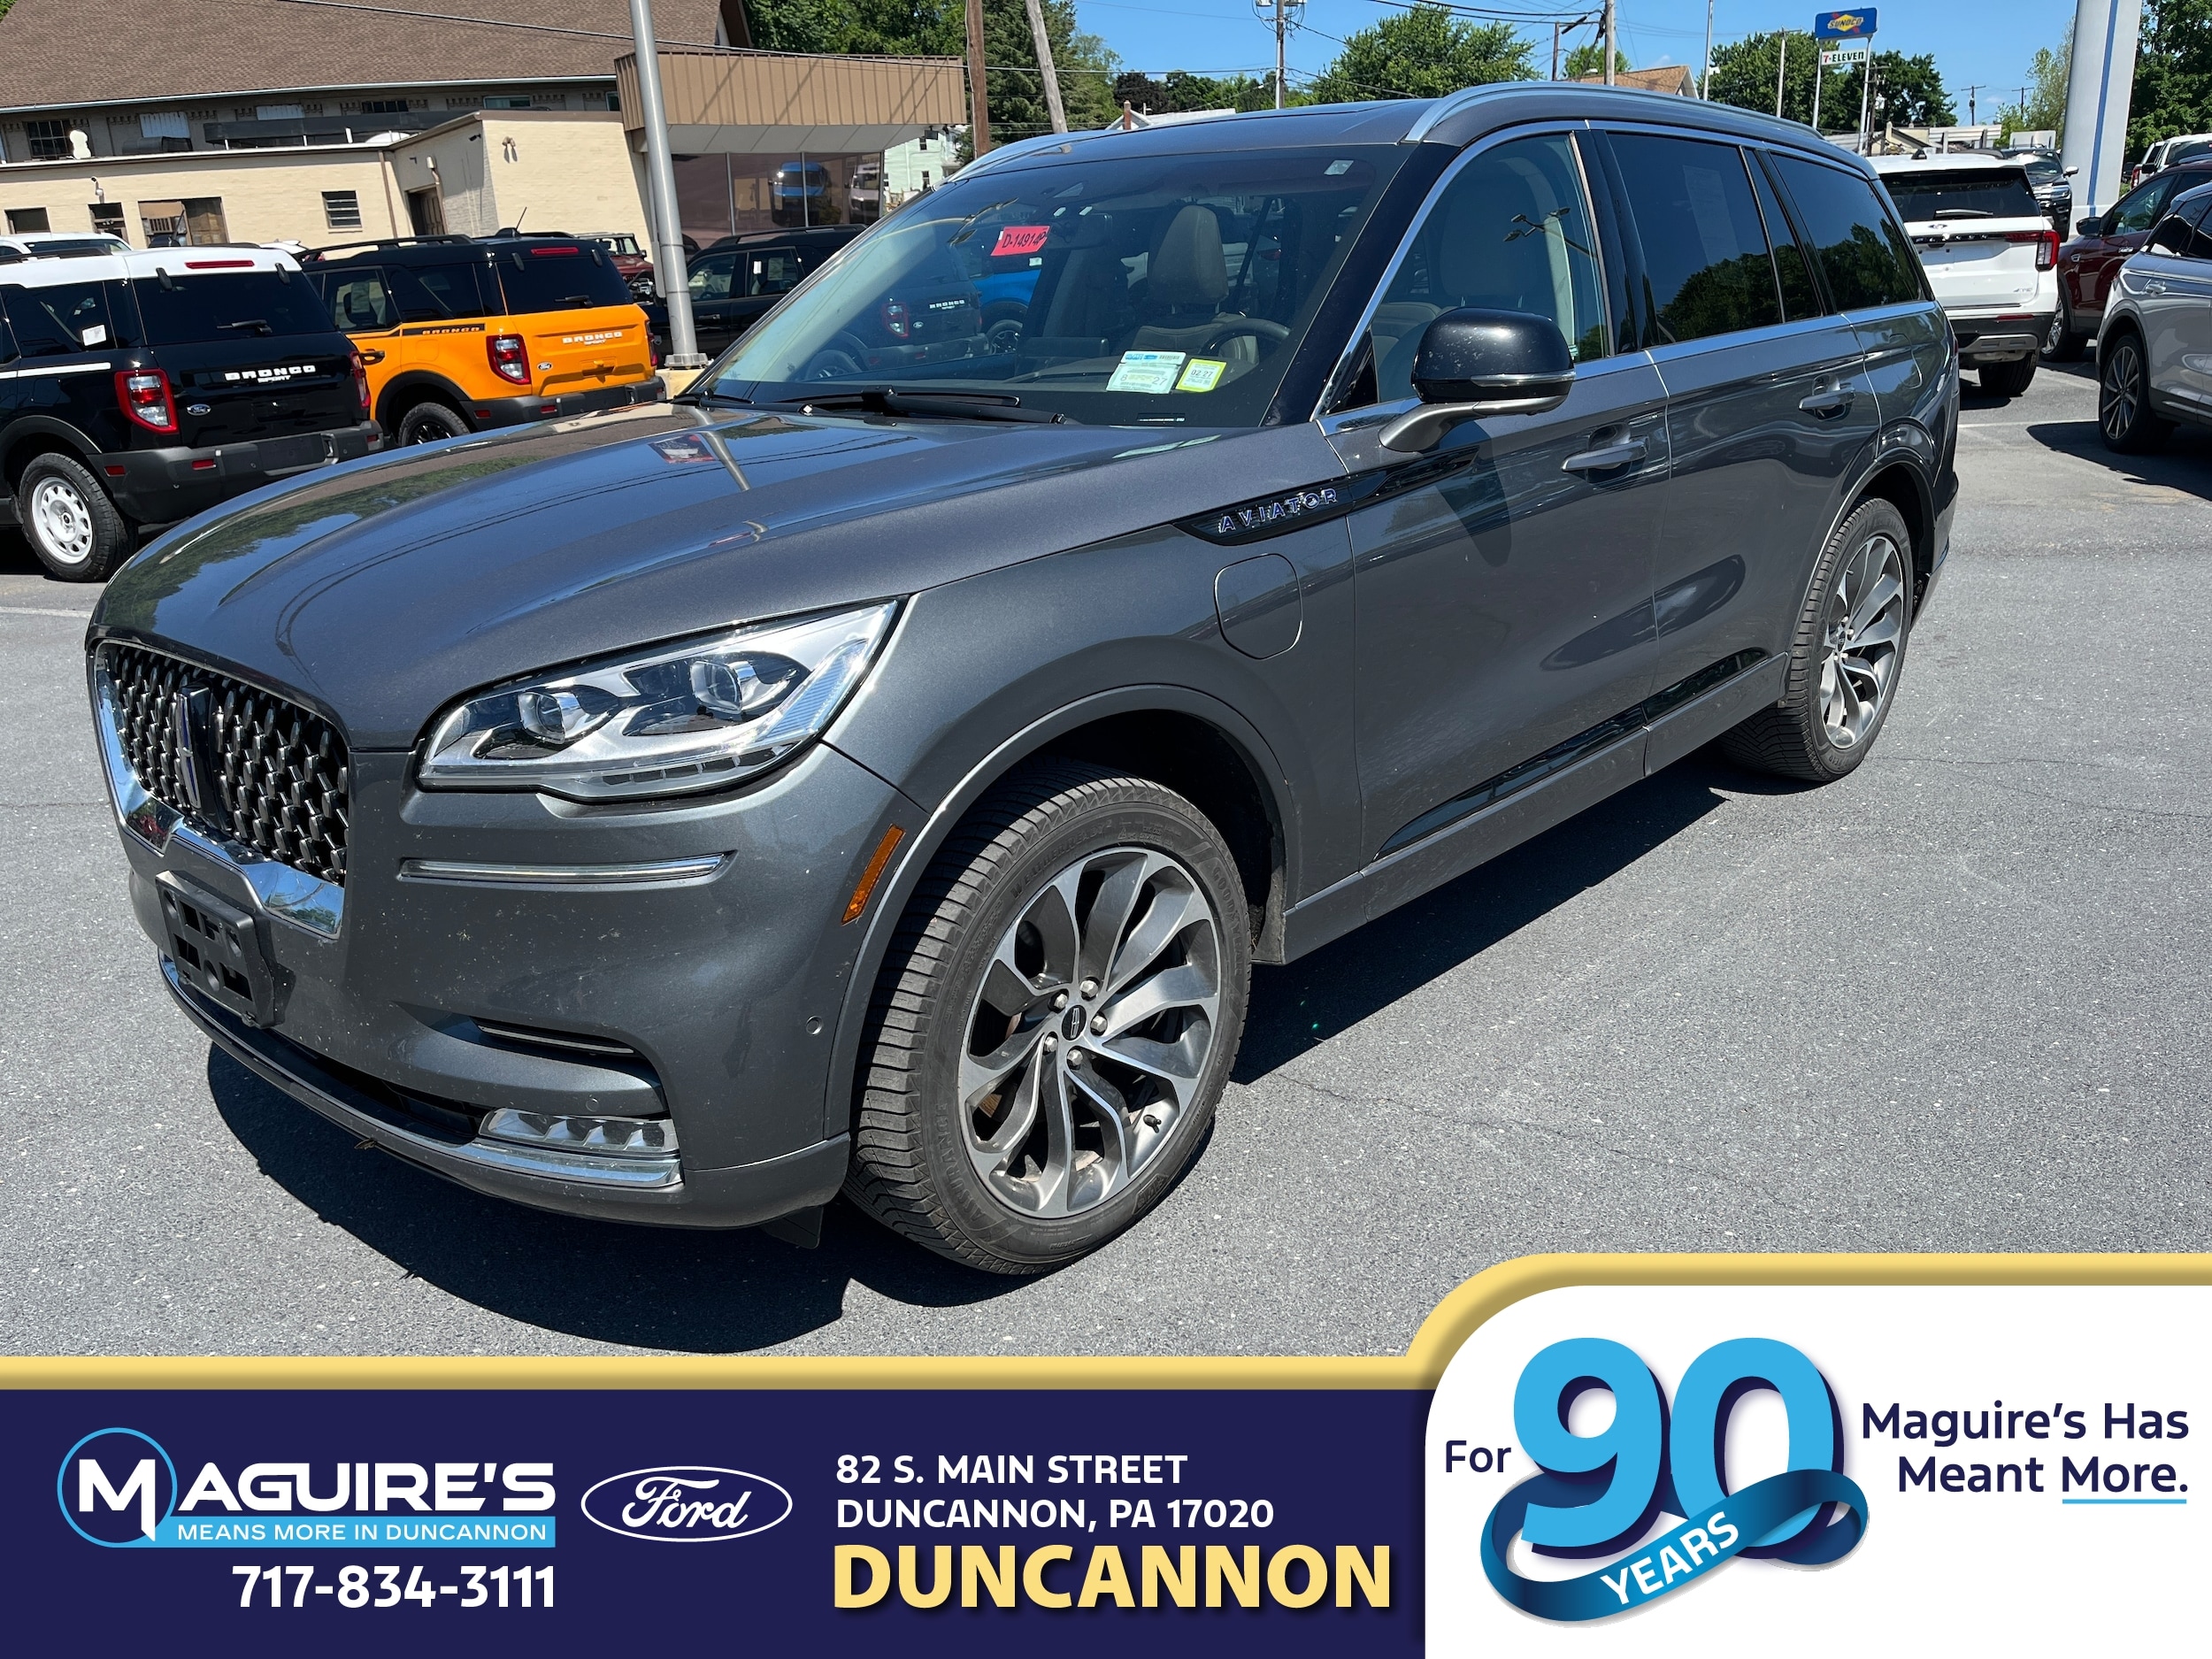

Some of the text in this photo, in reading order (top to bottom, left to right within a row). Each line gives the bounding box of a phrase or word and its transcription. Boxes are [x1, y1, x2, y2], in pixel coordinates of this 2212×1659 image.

[1829, 18, 1863, 28] SUNOCO
[562, 331, 623, 344] BRONCO
[224, 365, 317, 381] BRONCO
[1202, 370, 1213, 379] 27
[1151, 376, 1168, 387] 27
[1218, 488, 1338, 534] AVIATOR
[1212, 866, 1244, 978] GOODYEAR
[935, 1102, 986, 1221] ASSURANCE
